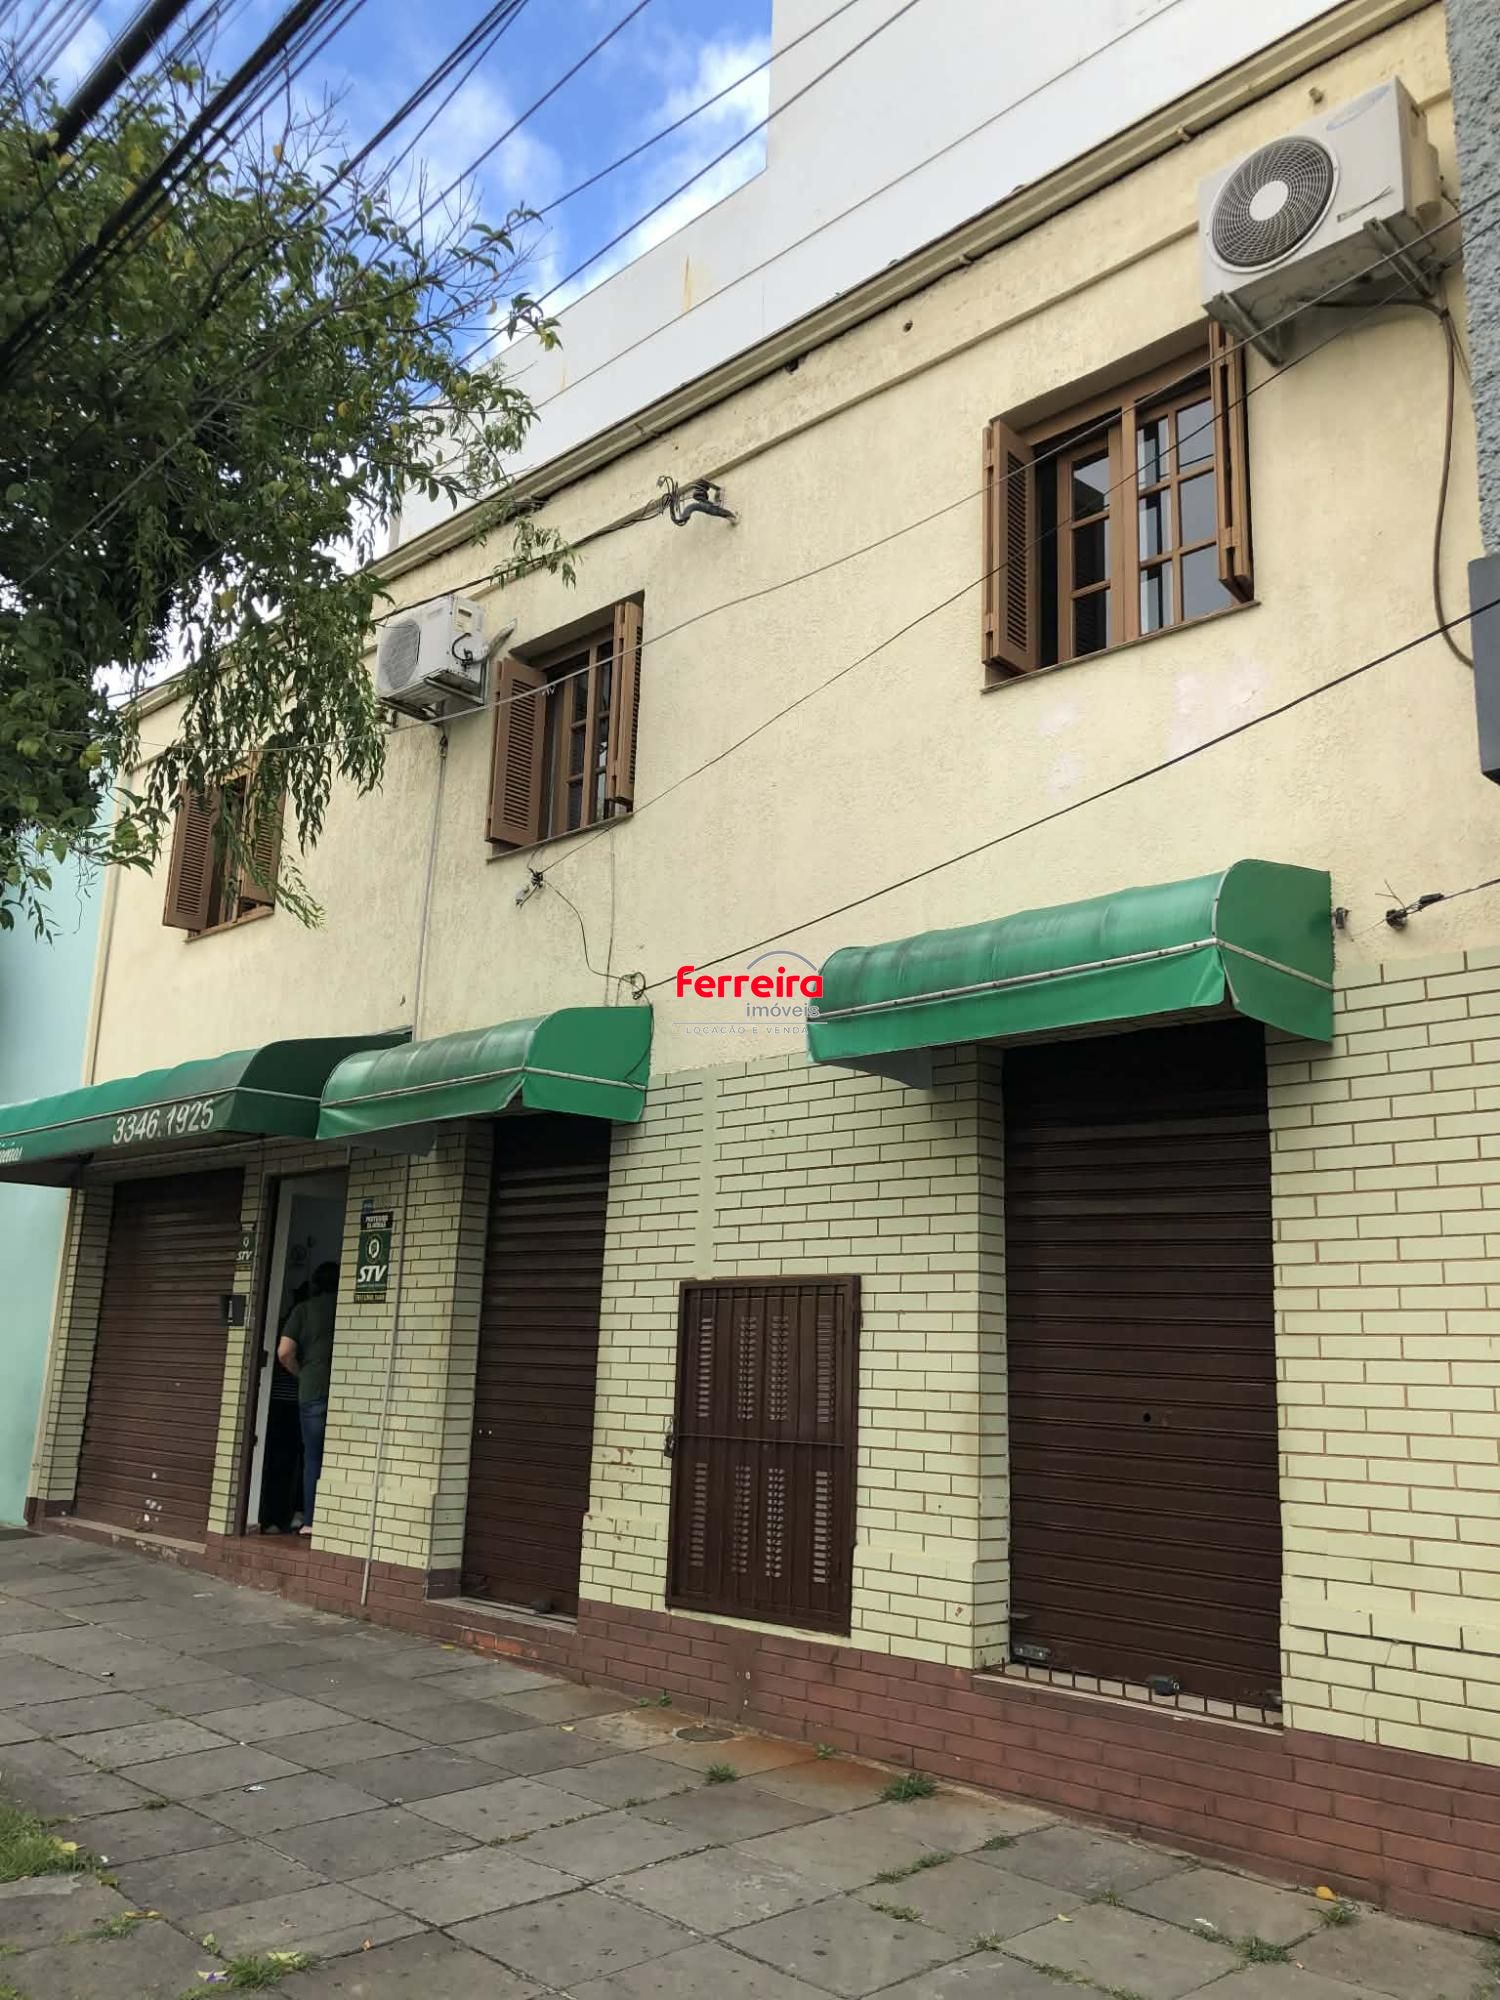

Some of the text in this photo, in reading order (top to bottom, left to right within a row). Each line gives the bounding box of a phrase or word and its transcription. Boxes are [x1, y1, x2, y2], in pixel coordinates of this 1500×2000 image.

[112, 1099, 214, 1145] 3346.1925
[236, 1250, 253, 1261] STV
[357, 1264, 387, 1283] STV
